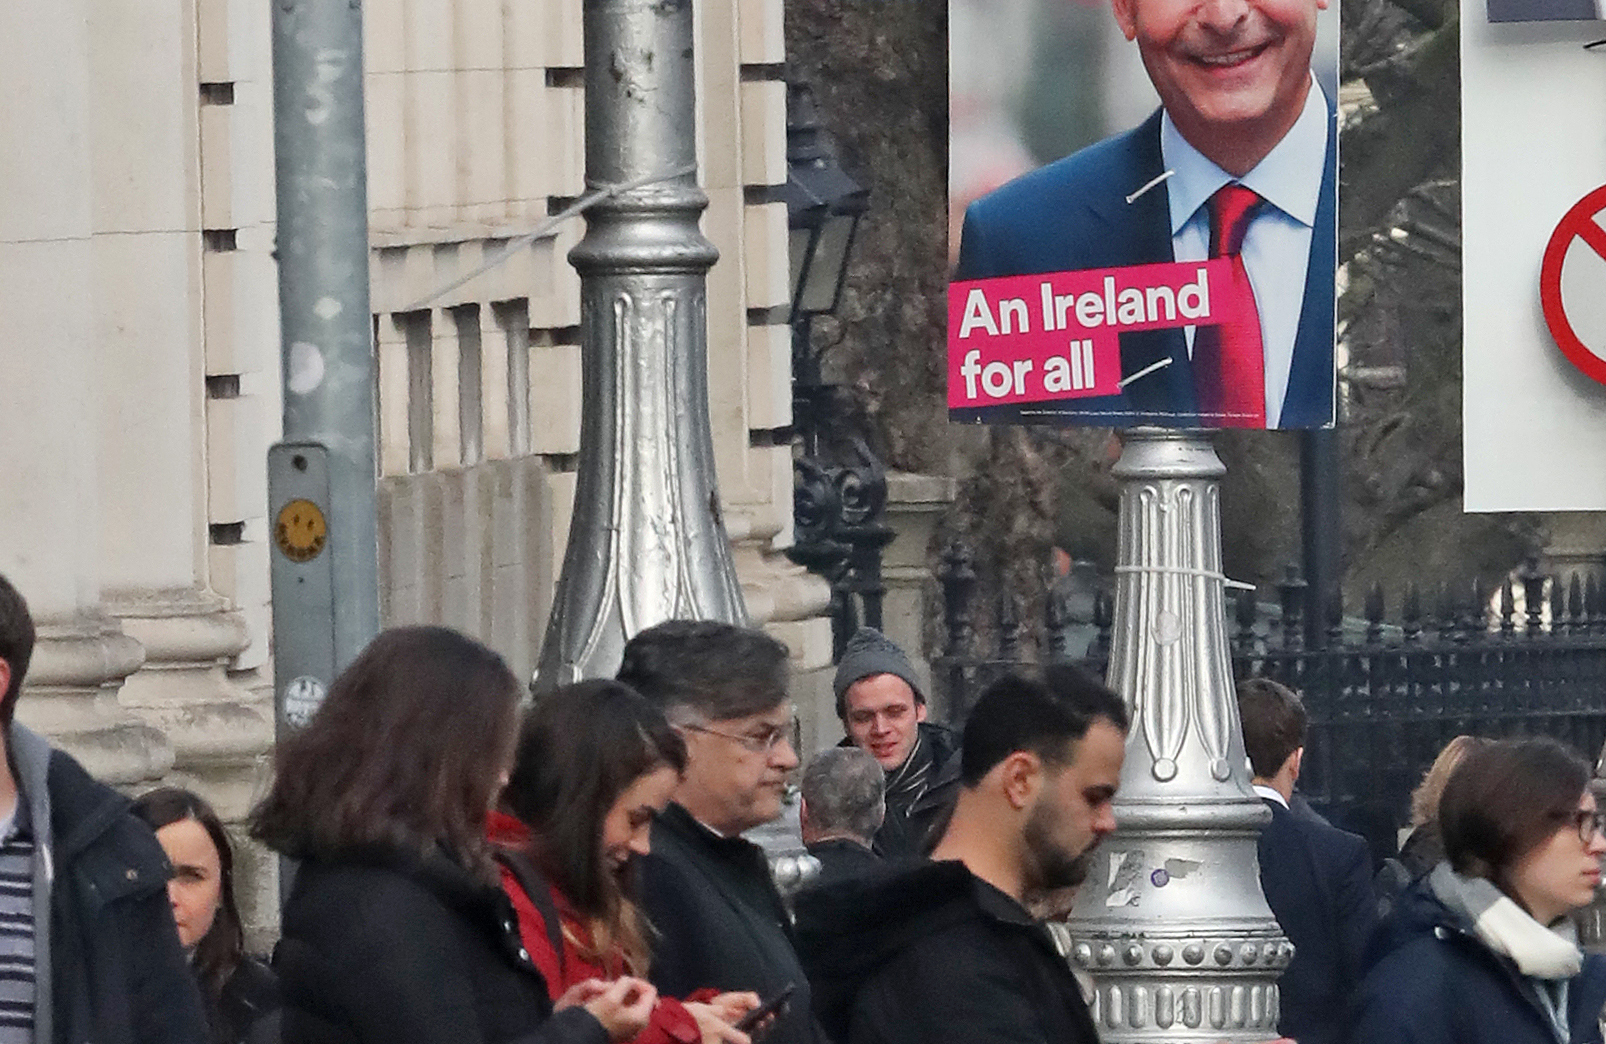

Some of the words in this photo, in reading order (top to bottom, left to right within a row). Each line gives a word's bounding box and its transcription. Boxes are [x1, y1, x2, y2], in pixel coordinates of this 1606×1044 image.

[958, 288, 1031, 340] An
[1040, 267, 1212, 332] Ireland
[960, 349, 1035, 400] for
[1043, 337, 1097, 394] all
